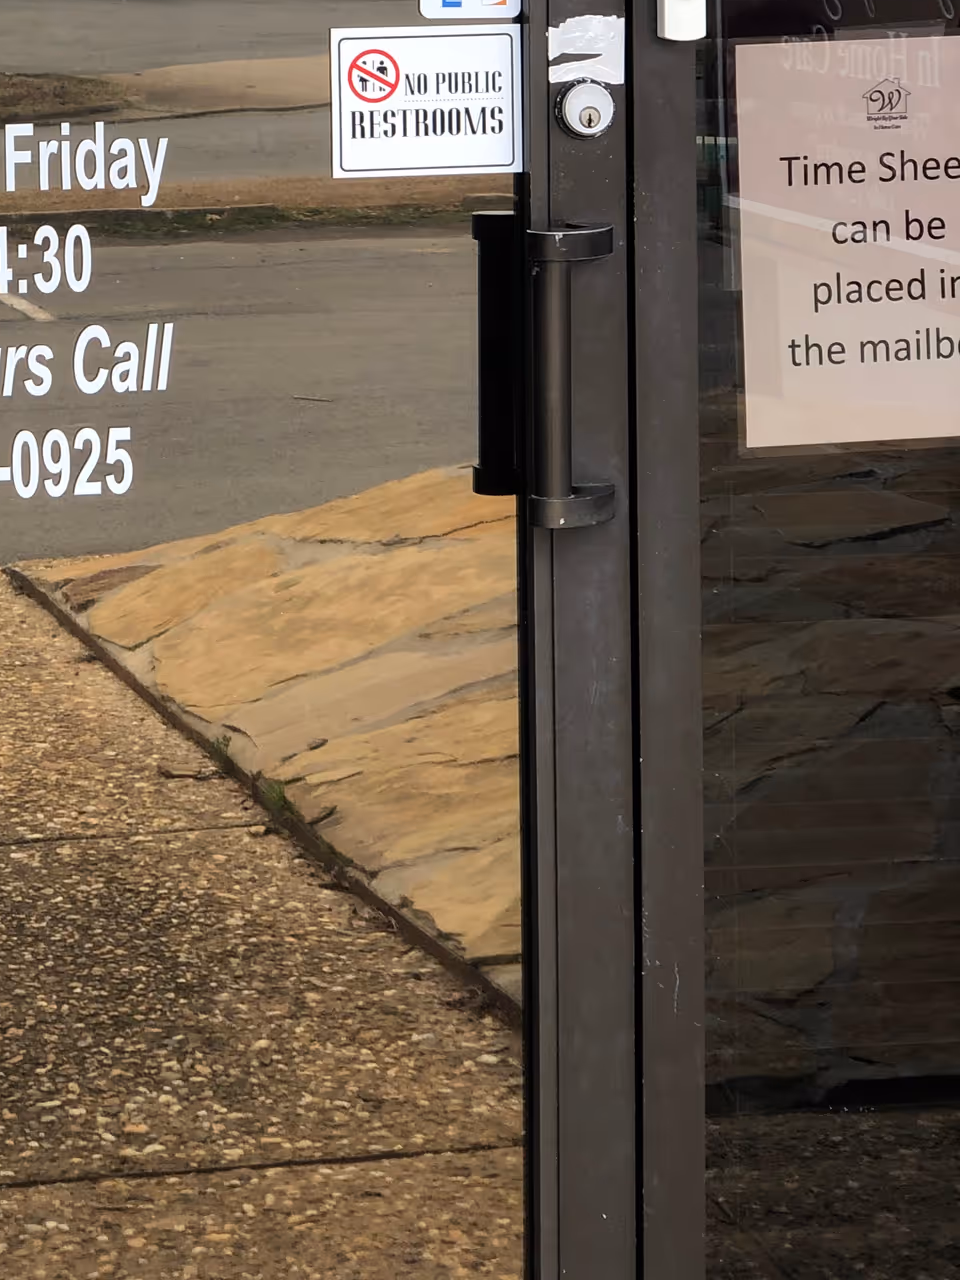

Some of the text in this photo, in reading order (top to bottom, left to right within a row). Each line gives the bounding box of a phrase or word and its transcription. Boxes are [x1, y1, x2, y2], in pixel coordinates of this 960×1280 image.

[404, 70, 503, 96] NO PUBLIC
[350, 106, 504, 139] RESTROOMS
[4, 121, 169, 207] Friday
[779, 155, 867, 187] Time
[831, 209, 946, 244] can be
[813, 268, 927, 313] placed
[73, 322, 174, 394] Call
[788, 327, 960, 367] the mailb
